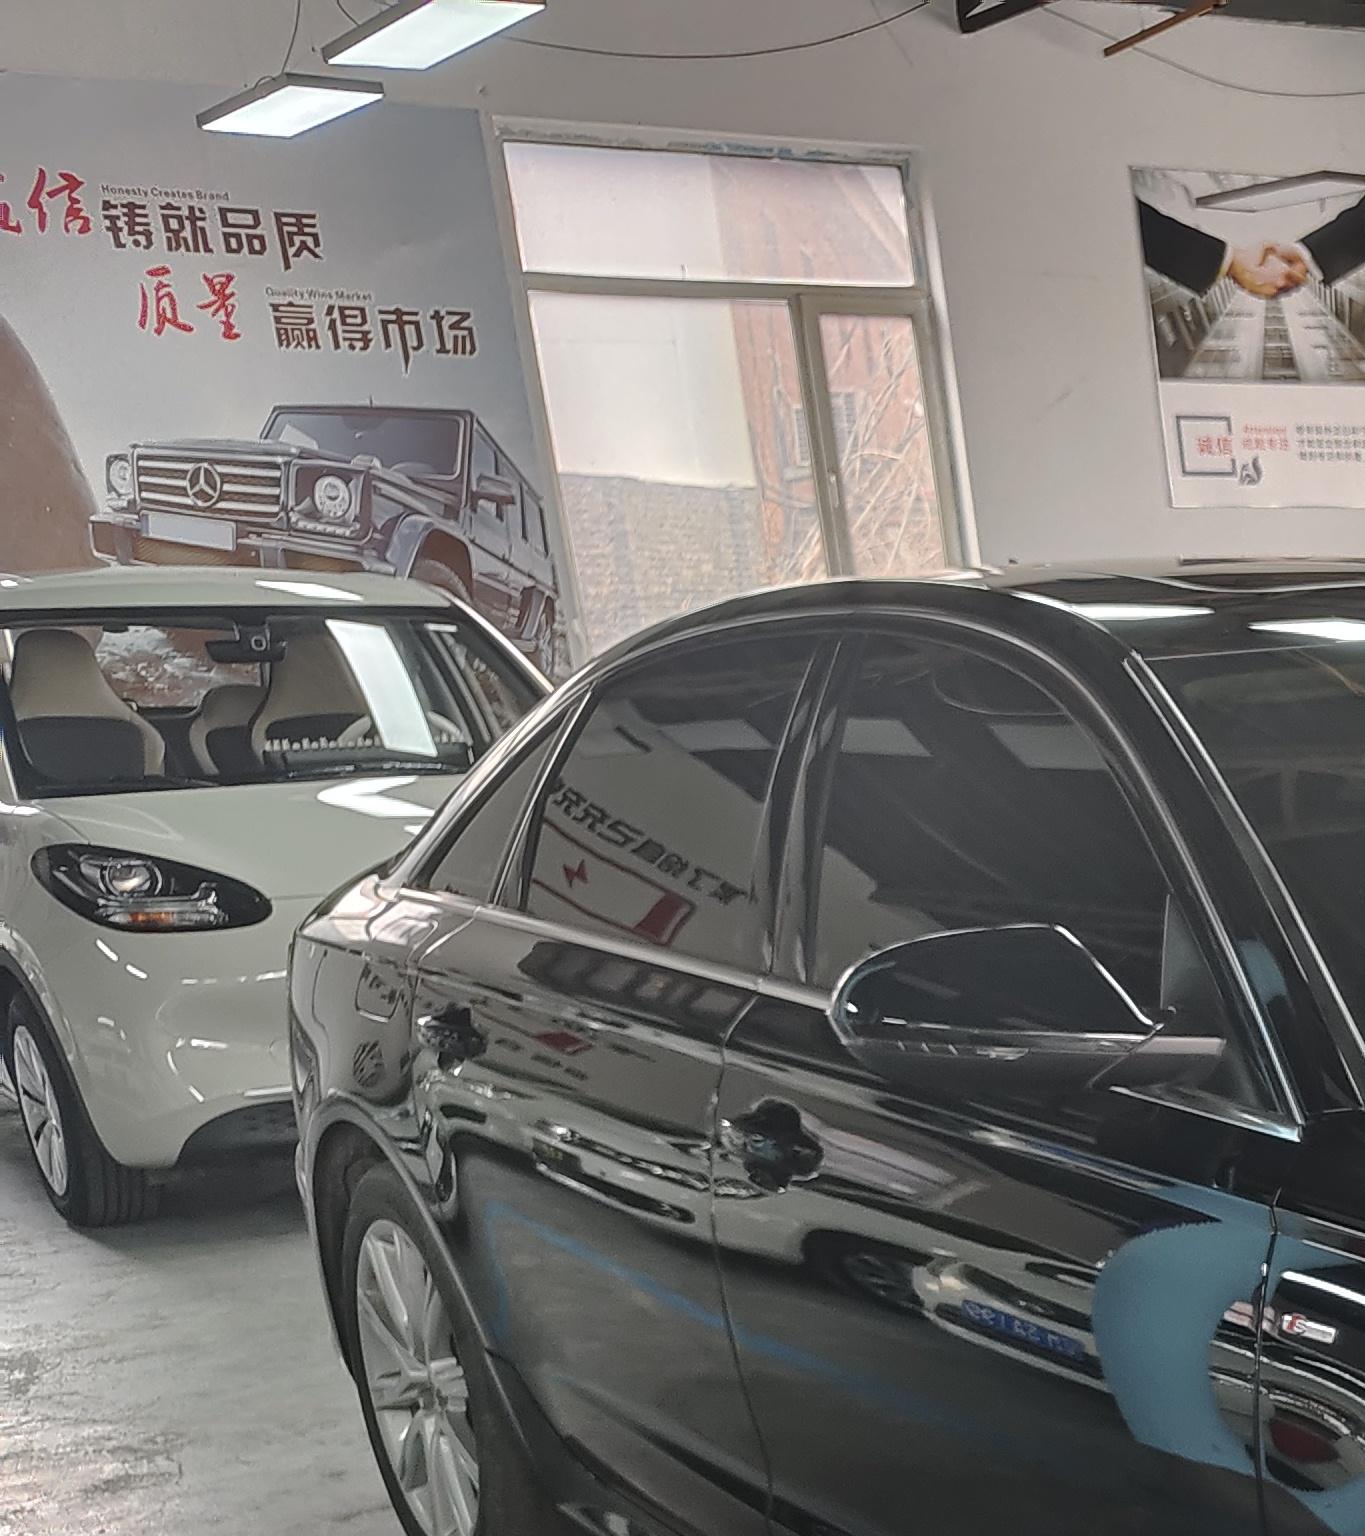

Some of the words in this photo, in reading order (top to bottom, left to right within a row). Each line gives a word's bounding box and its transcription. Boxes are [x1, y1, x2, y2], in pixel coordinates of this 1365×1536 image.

[100, 184, 148, 198] Honesty
[150, 187, 194, 200] Creates
[195, 190, 230, 202] Brand
[101, 199, 324, 272] 铸就品质
[269, 301, 477, 375] 赢得市场
